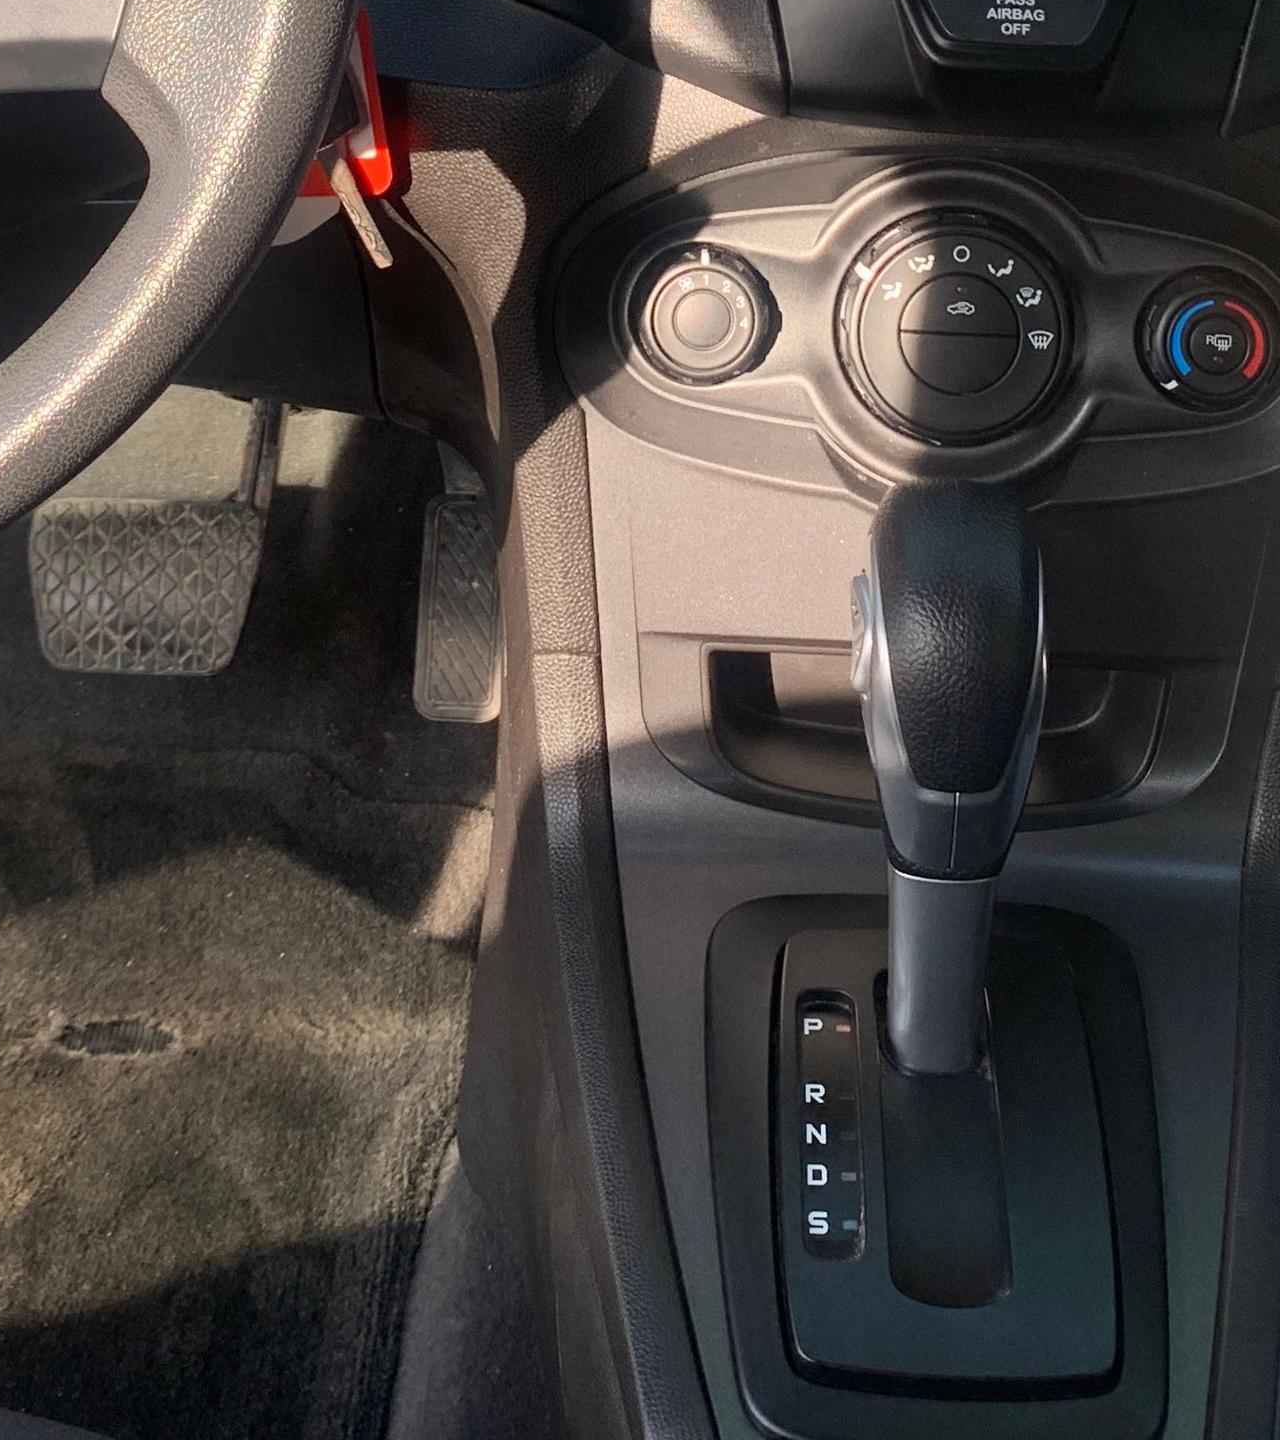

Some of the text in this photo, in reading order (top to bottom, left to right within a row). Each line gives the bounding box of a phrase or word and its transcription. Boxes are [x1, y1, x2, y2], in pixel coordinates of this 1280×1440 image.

[986, 8, 1045, 21] AIRBAG
[1000, 22, 1031, 35] OFF
[702, 274, 710, 287] 1
[722, 280, 732, 293] 2
[735, 295, 746, 308] 3
[739, 316, 749, 329] 4
[804, 1018, 823, 1035] P
[805, 1083, 826, 1104] R
[805, 1123, 827, 1145] N
[806, 1163, 828, 1187] D
[807, 1211, 829, 1235] S
